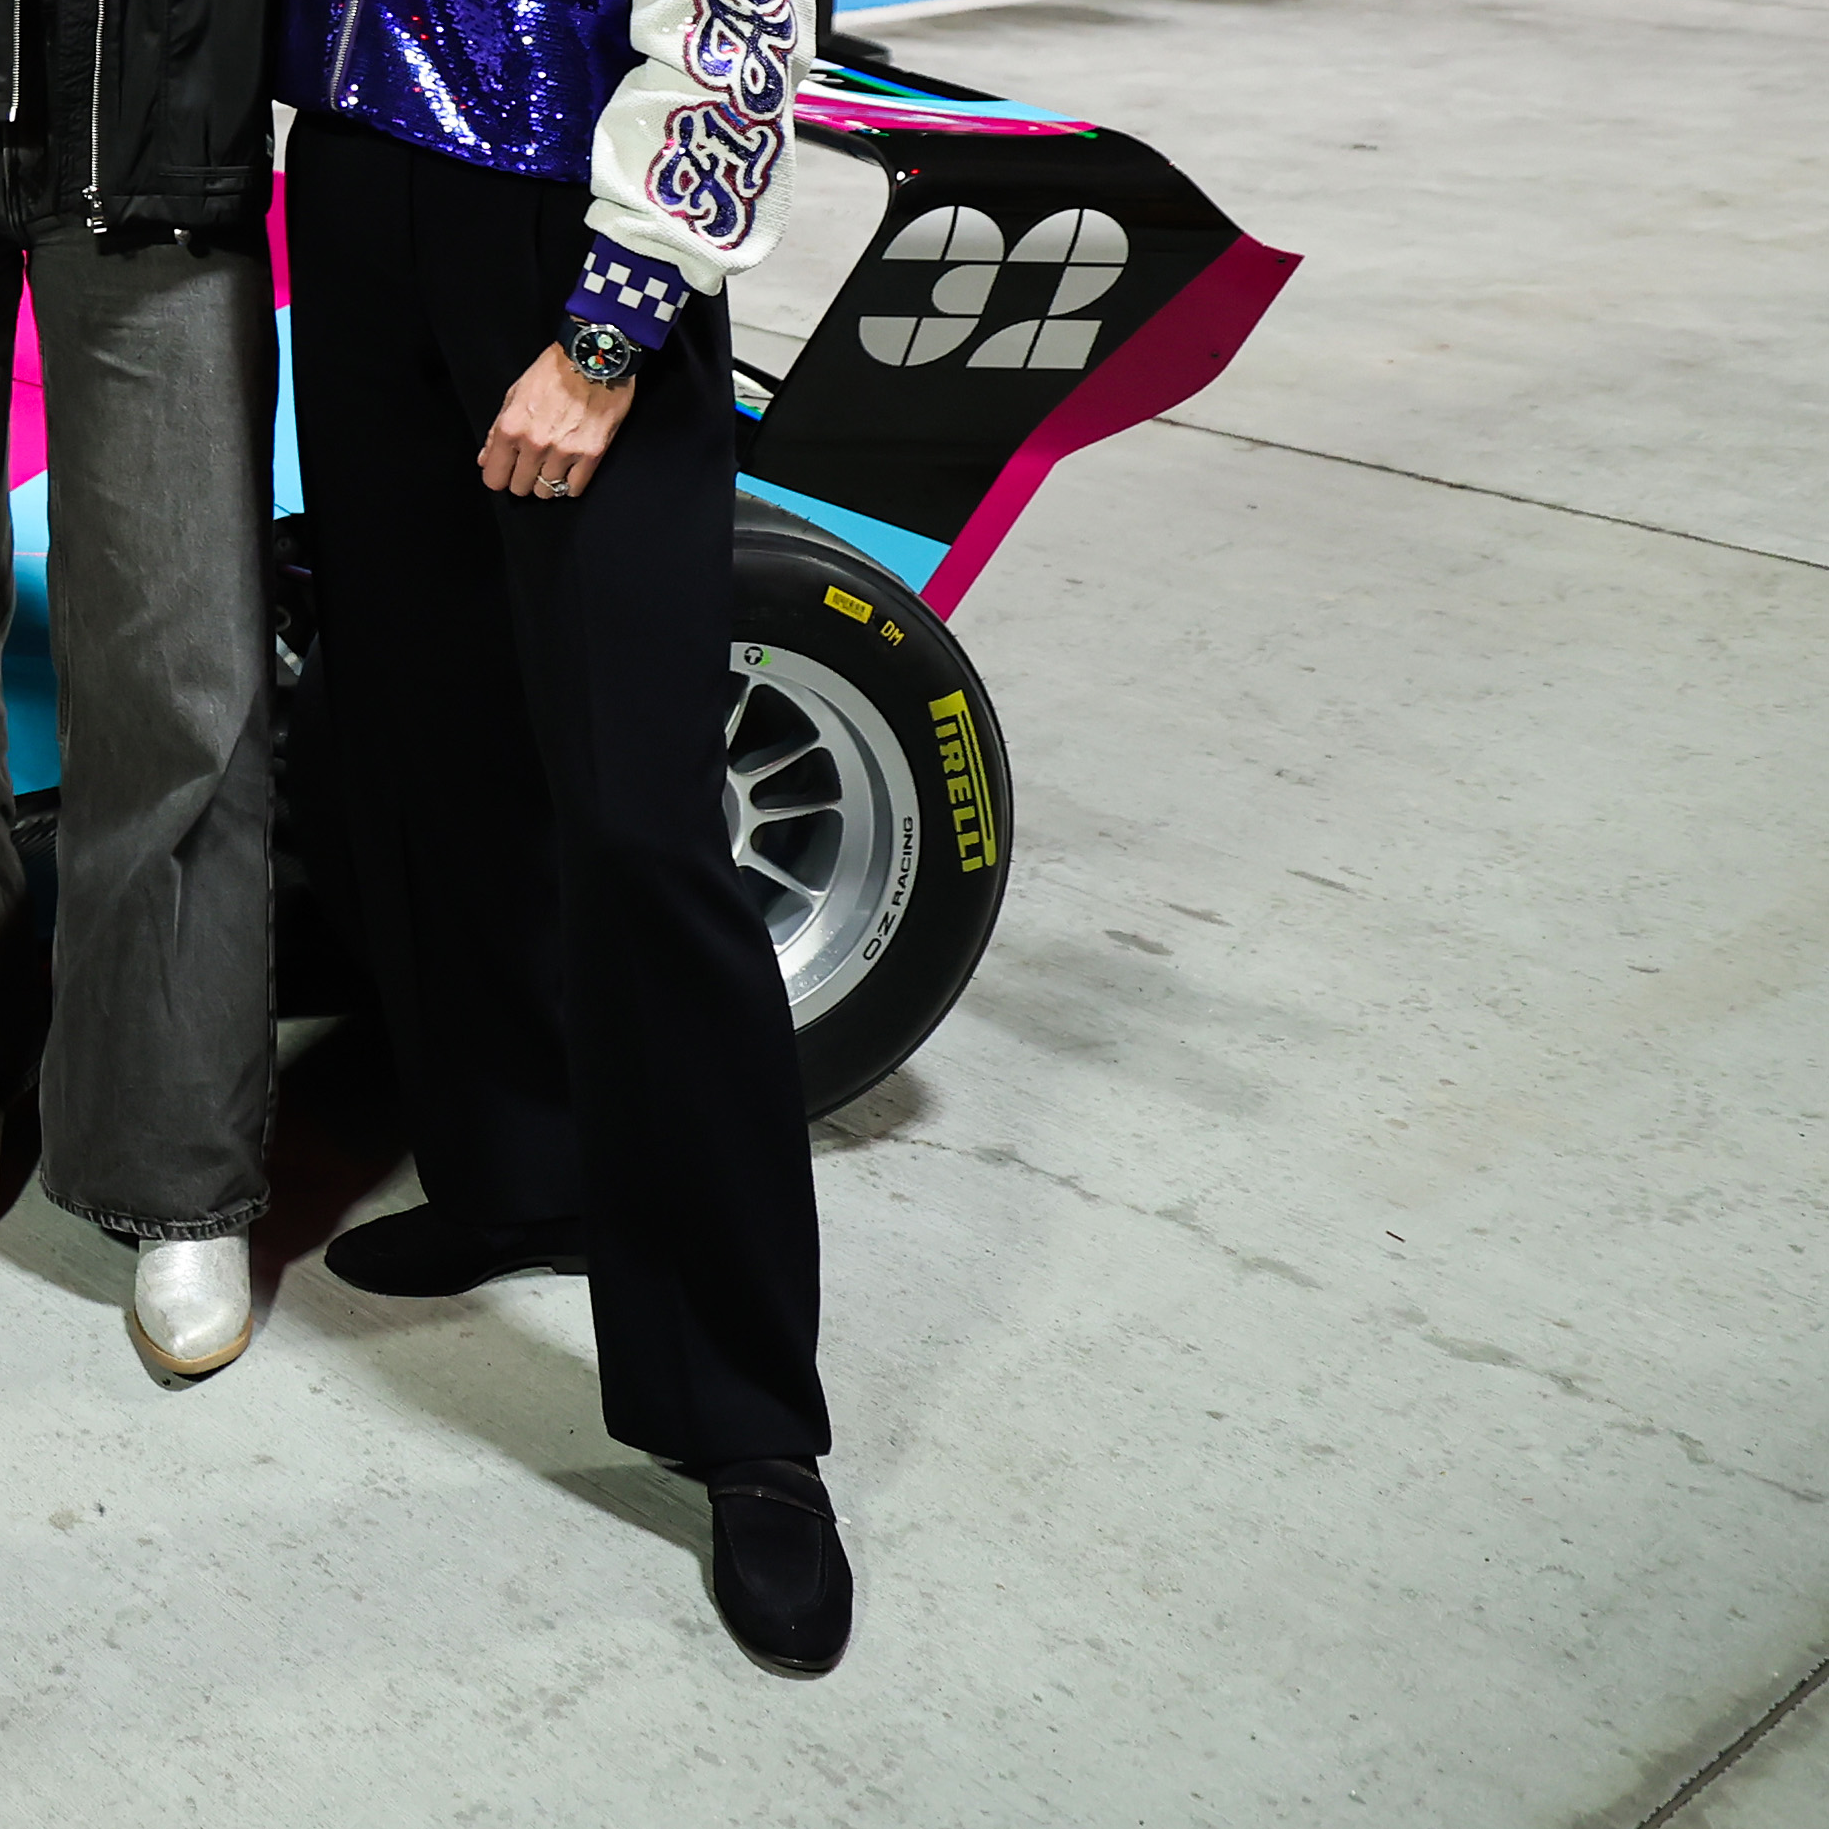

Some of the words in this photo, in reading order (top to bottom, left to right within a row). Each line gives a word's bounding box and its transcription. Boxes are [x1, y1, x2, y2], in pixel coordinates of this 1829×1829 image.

[858, 205, 1130, 370] 32
[880, 619, 906, 647] DM
[929, 689, 997, 874] PIRELLI
[893, 816, 914, 908] RACING
